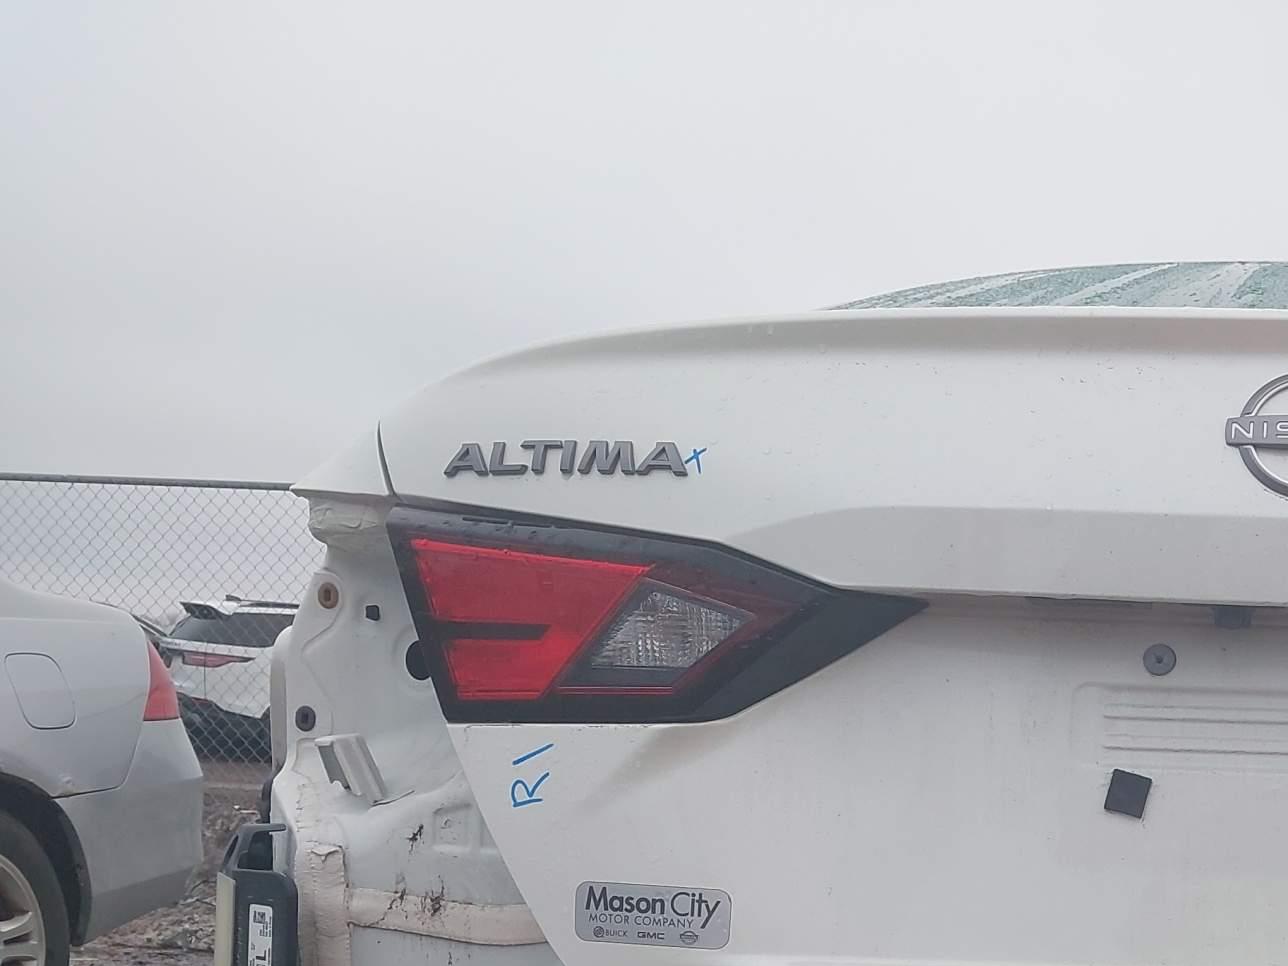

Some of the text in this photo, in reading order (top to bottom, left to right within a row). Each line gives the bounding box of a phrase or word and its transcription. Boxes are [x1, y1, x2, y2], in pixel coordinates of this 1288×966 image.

[443, 439, 689, 477] ALTIMA
[585, 885, 721, 930] Mason City
[588, 913, 694, 929] MOTOR COMPANY
[605, 929, 628, 937] BUICK
[637, 931, 665, 940] GMC
[255, 949, 267, 961] L
